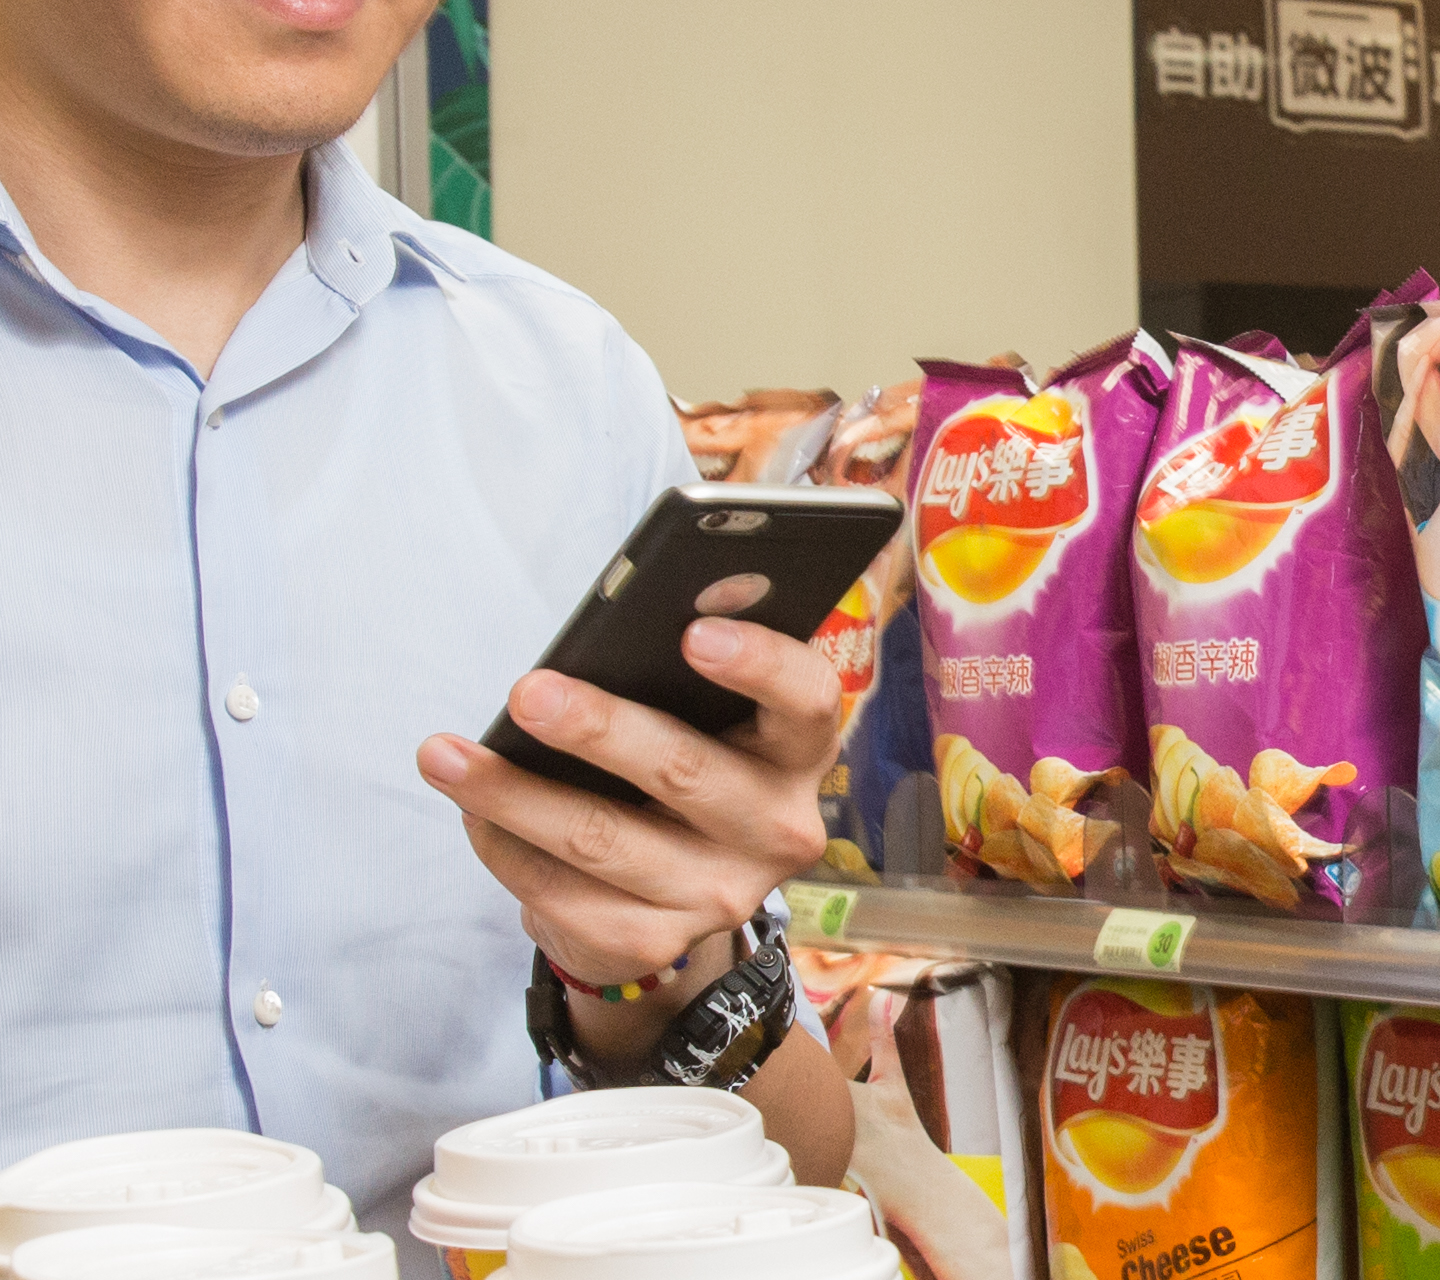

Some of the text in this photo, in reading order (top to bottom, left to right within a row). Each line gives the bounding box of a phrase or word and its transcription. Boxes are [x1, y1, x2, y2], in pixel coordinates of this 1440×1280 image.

[1150, 27, 1263, 101] 自助
[1288, 31, 1398, 114] 微波
[923, 435, 1082, 518] Lay's樂事
[1154, 933, 1173, 954] 30
[1054, 1022, 1212, 1102] Lay's樂事
[1117, 1229, 1155, 1259] Swiss
